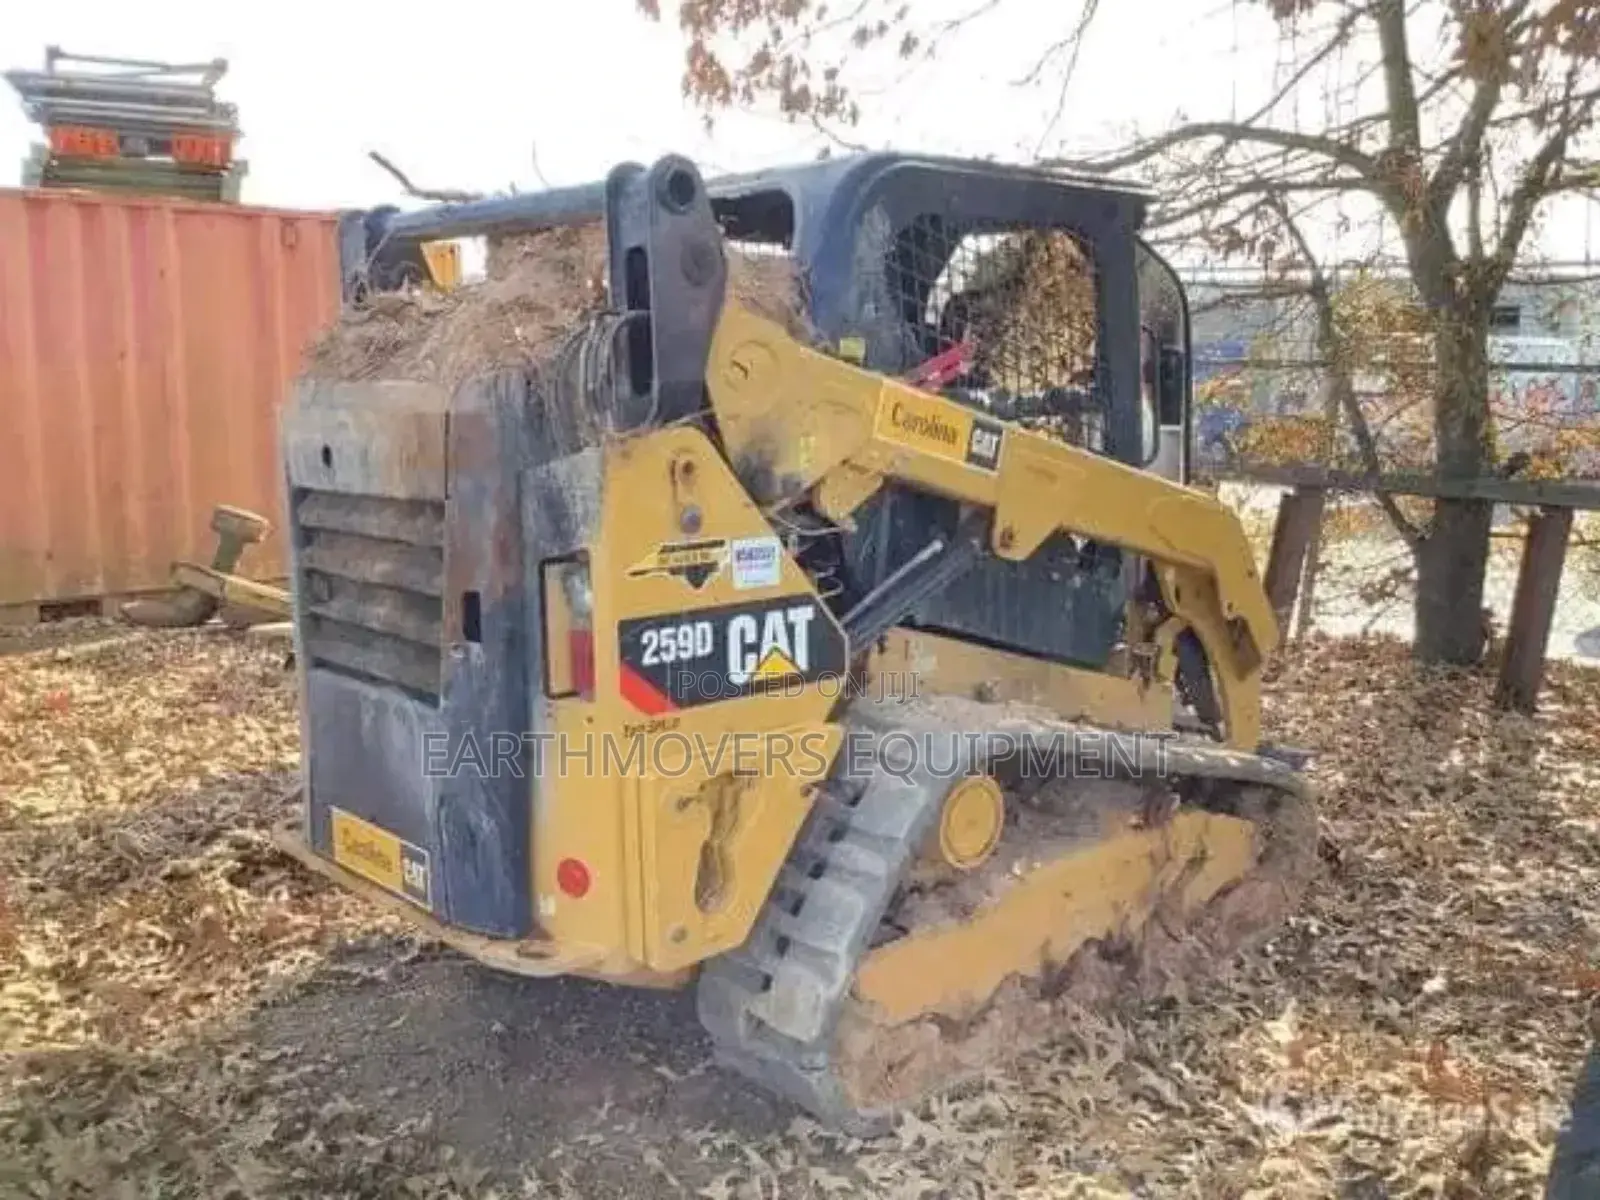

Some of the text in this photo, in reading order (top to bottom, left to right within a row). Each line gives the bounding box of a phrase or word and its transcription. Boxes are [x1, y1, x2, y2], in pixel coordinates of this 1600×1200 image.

[971, 428, 1000, 460] CAT
[640, 604, 815, 685] 259D CAT
